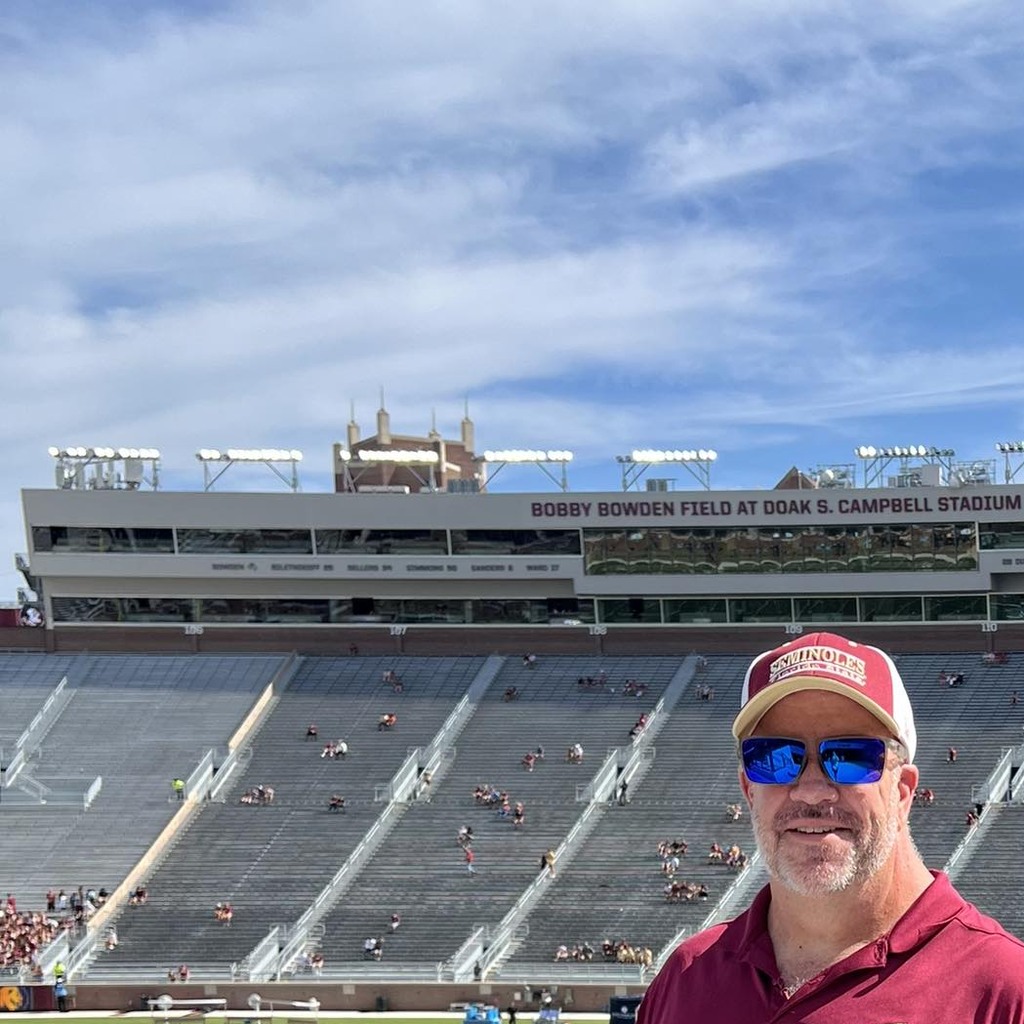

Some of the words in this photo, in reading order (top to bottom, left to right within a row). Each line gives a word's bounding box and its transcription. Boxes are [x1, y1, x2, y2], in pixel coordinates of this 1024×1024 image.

[531, 502, 592, 518] BOBBY
[598, 501, 675, 517] BOWDEN
[681, 501, 732, 517] FIELD
[737, 500, 758, 516] AT
[763, 499, 812, 515] DOAK
[817, 499, 833, 514] S.
[838, 498, 933, 514] CAMPBELL
[938, 495, 1022, 512] STADIUM
[769, 647, 867, 678] SEMINOLES
